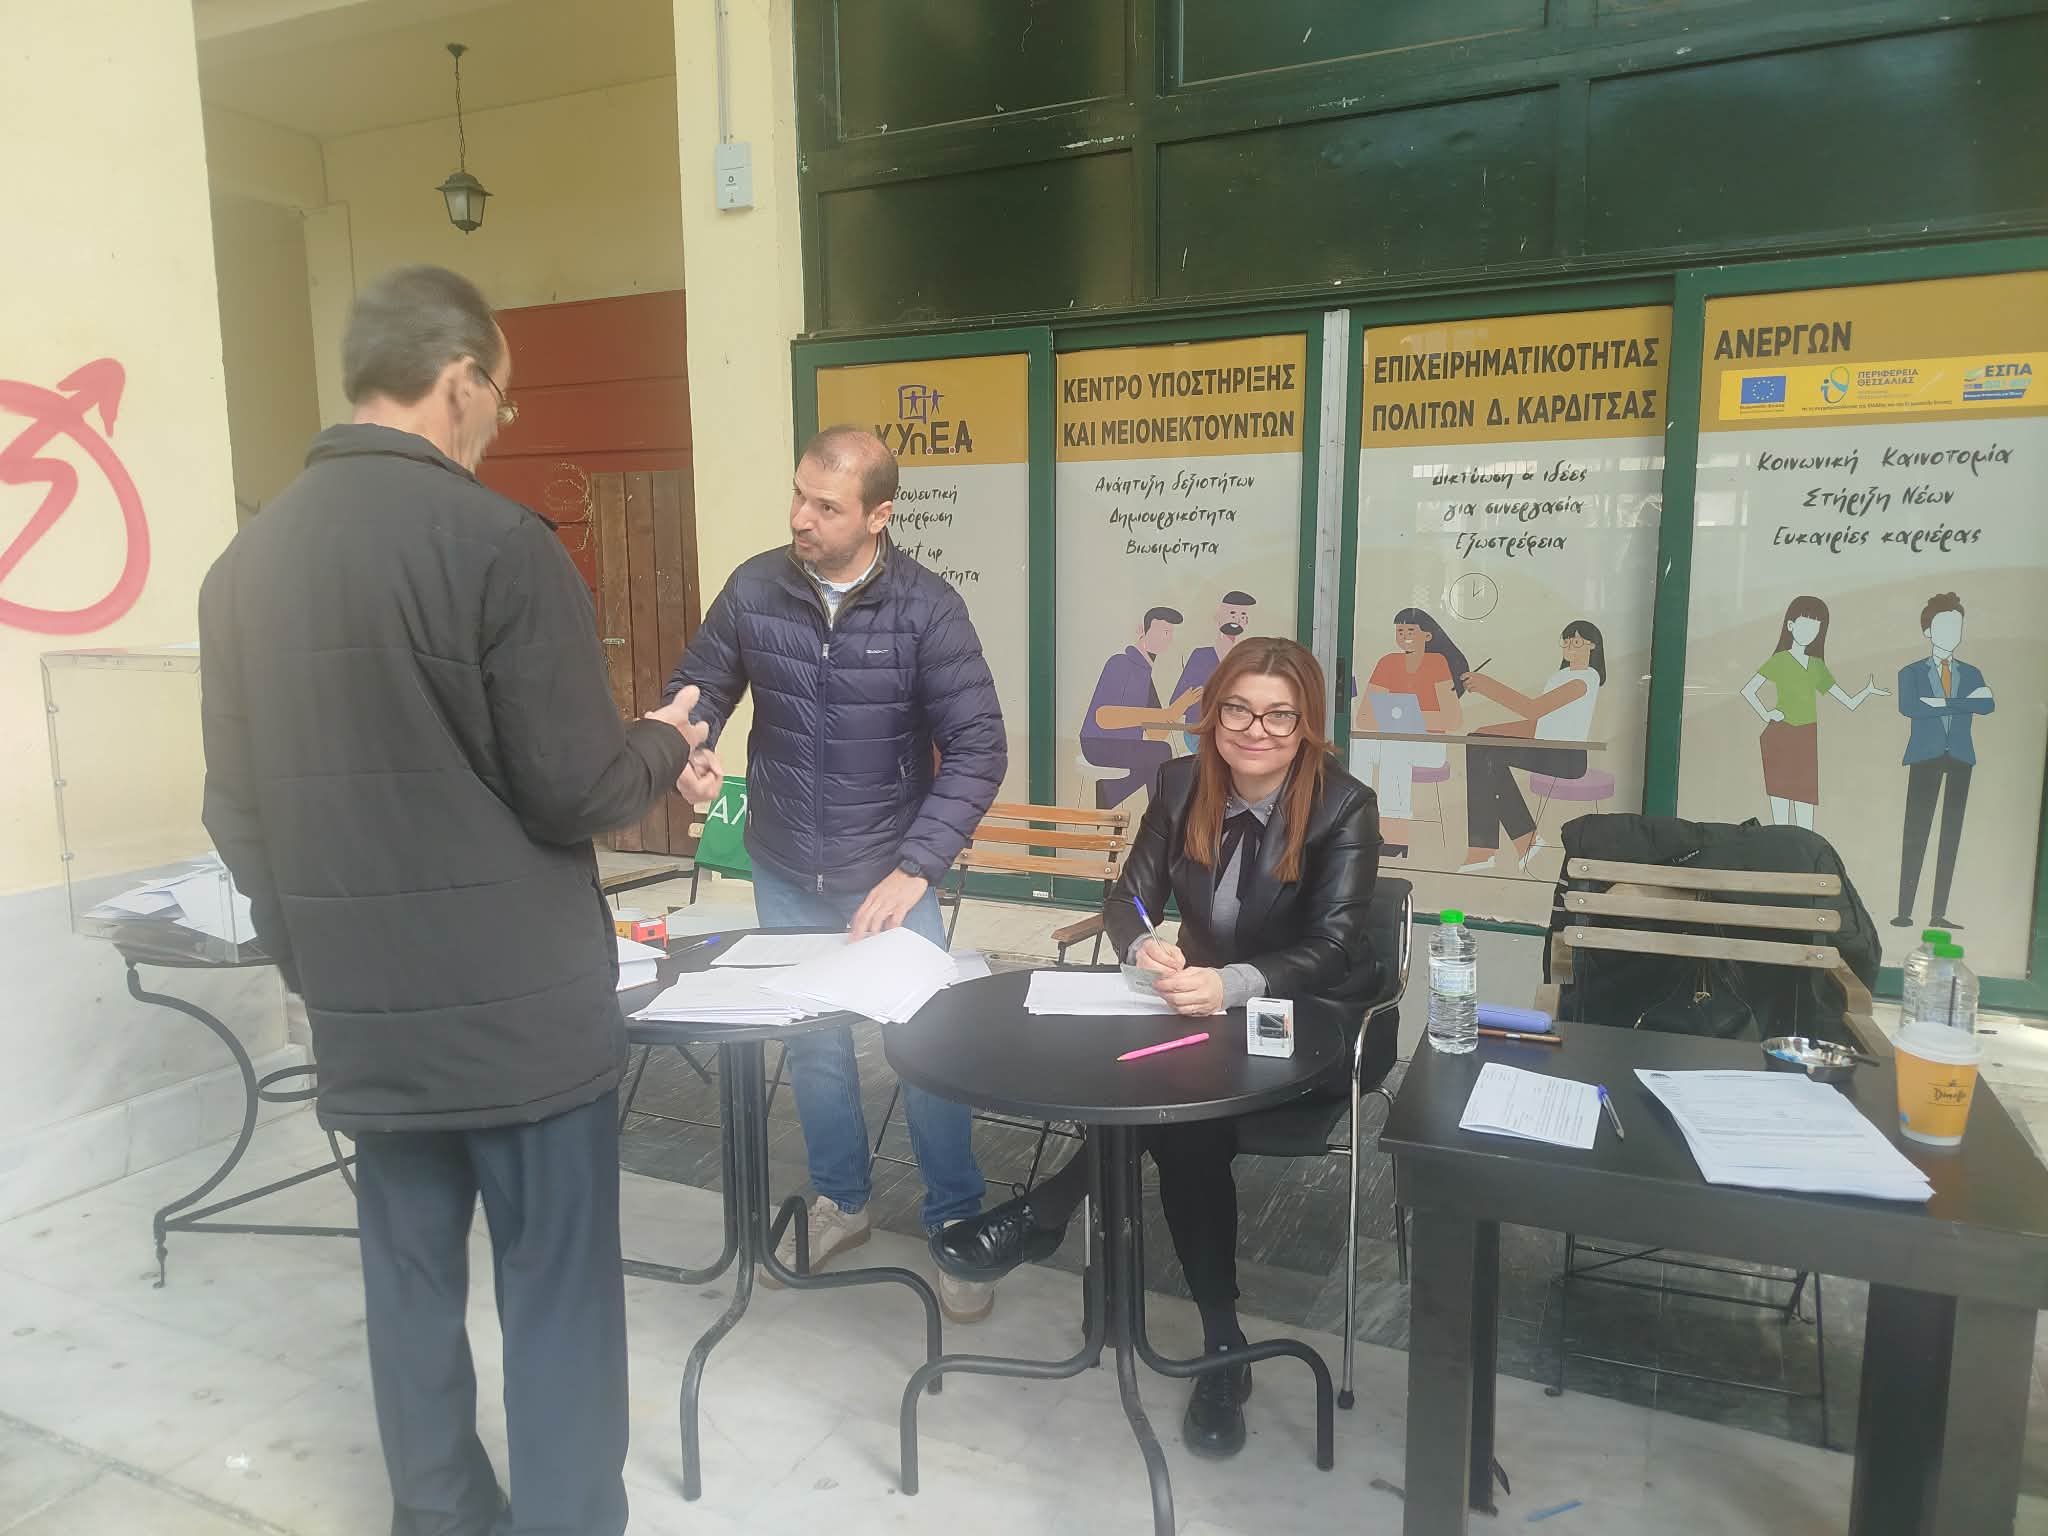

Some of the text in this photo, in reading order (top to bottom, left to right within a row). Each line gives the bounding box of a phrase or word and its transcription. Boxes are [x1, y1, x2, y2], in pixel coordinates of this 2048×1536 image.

[1714, 321, 1853, 360] ΑΝΕΡΓΩΝ
[1374, 338, 1660, 384] ΕΠΙΧΕΙΡΗΜΑΤΙΚΟΤΗΤΑΣ
[1857, 368, 1919, 379] ΠΕΡΙΦΕΡΕΙΑ
[1985, 363, 2032, 377] ΕΣΠΑ
[1063, 364, 1296, 404] ΚΕΝΤΡΟ ΥΠΟΣΤΗΡΙΞΗΣ
[1856, 376, 1915, 387] ΘΕΣΣΑΛΙΑΣ
[1372, 390, 1657, 431] ΠΟΛΙΤΩΝ Δ. ΚΑΡΔΙΤΣΑΣ
[1063, 410, 1295, 447] ΚΑΙ ΜΕΙΟΝΕΚΤΟΥΝΤΩΝ
[1543, 460, 1588, 482] ιδέες
[1758, 443, 2014, 477] Κοινωνική Καινοτομία
[1095, 470, 1255, 499] Ανάπτυξη δεξιοτήτων
[1443, 496, 1585, 522] για συνεργασία
[1802, 485, 1954, 517] Στήριξη Νέων
[888, 507, 953, 533] πιμόρφωση
[1109, 506, 1237, 533] Δημιουργικότητα
[1126, 538, 1220, 564] Βιωσιμότητα
[1455, 532, 1568, 559] Εξωστρέφεια
[1773, 523, 1982, 553] Ευκαιρίες καριέρας
[927, 547, 943, 563] up
